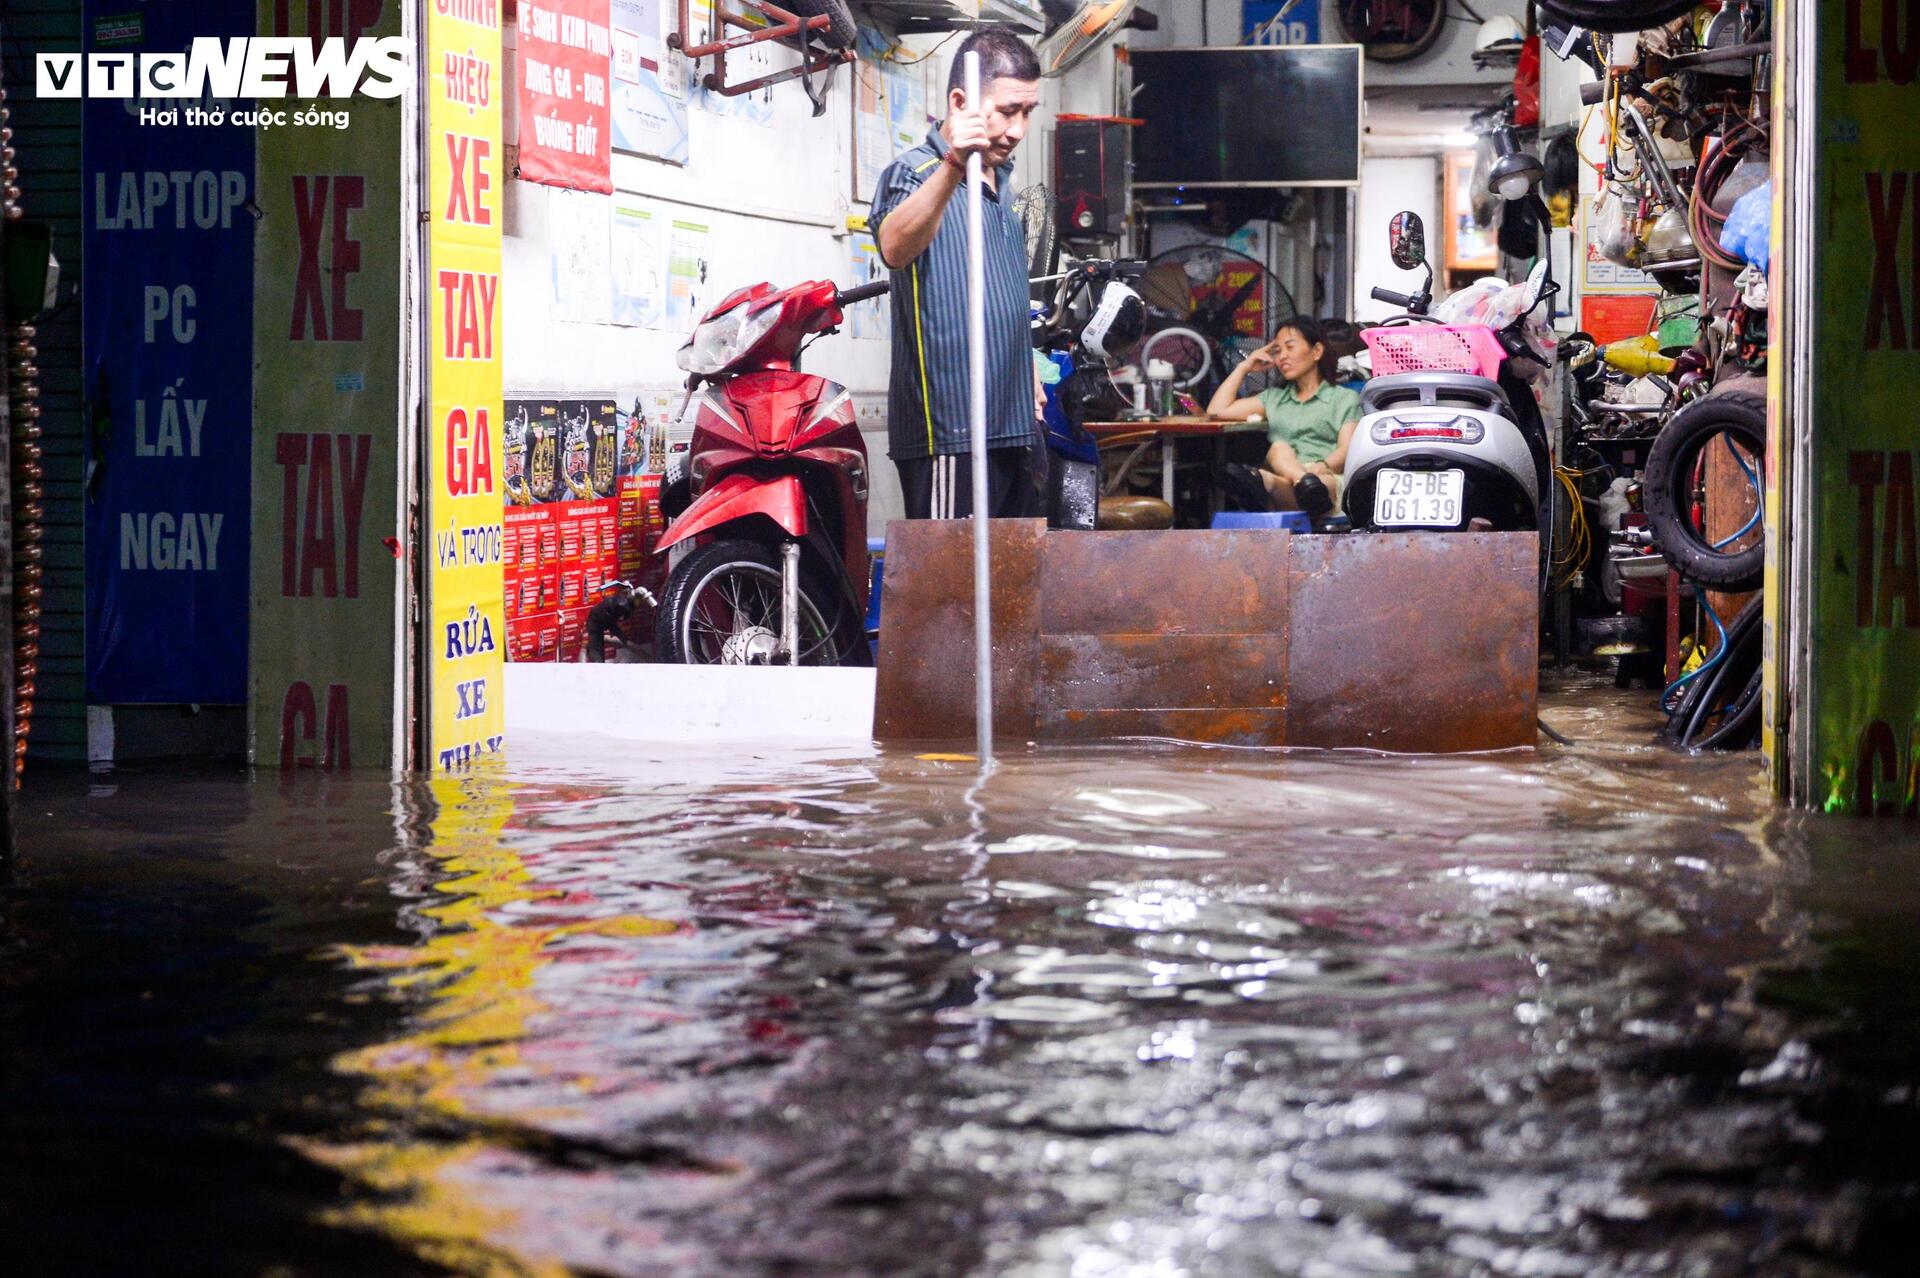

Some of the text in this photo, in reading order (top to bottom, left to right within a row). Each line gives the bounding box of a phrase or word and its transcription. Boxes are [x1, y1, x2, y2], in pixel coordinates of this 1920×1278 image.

[561, 14, 586, 49] KIM
[445, 49, 489, 114] HIỆU
[554, 66, 572, 99] GA
[96, 171, 246, 230] LAPTOP
[446, 134, 491, 226] XE
[290, 176, 364, 342] XE
[144, 285, 196, 344] PC
[439, 270, 497, 360] TAY
[135, 377, 208, 457] LẤY
[446, 408, 493, 496] GA
[1381, 498, 1455, 520] 061.39
[1389, 473, 1449, 495] 29-BE
[120, 512, 224, 571] NGAY
[276, 433, 371, 599] TAY
[438, 518, 457, 568] VÁ
[461, 525, 501, 566] TRONG
[446, 604, 494, 659] RỬA
[455, 679, 487, 720] XE
